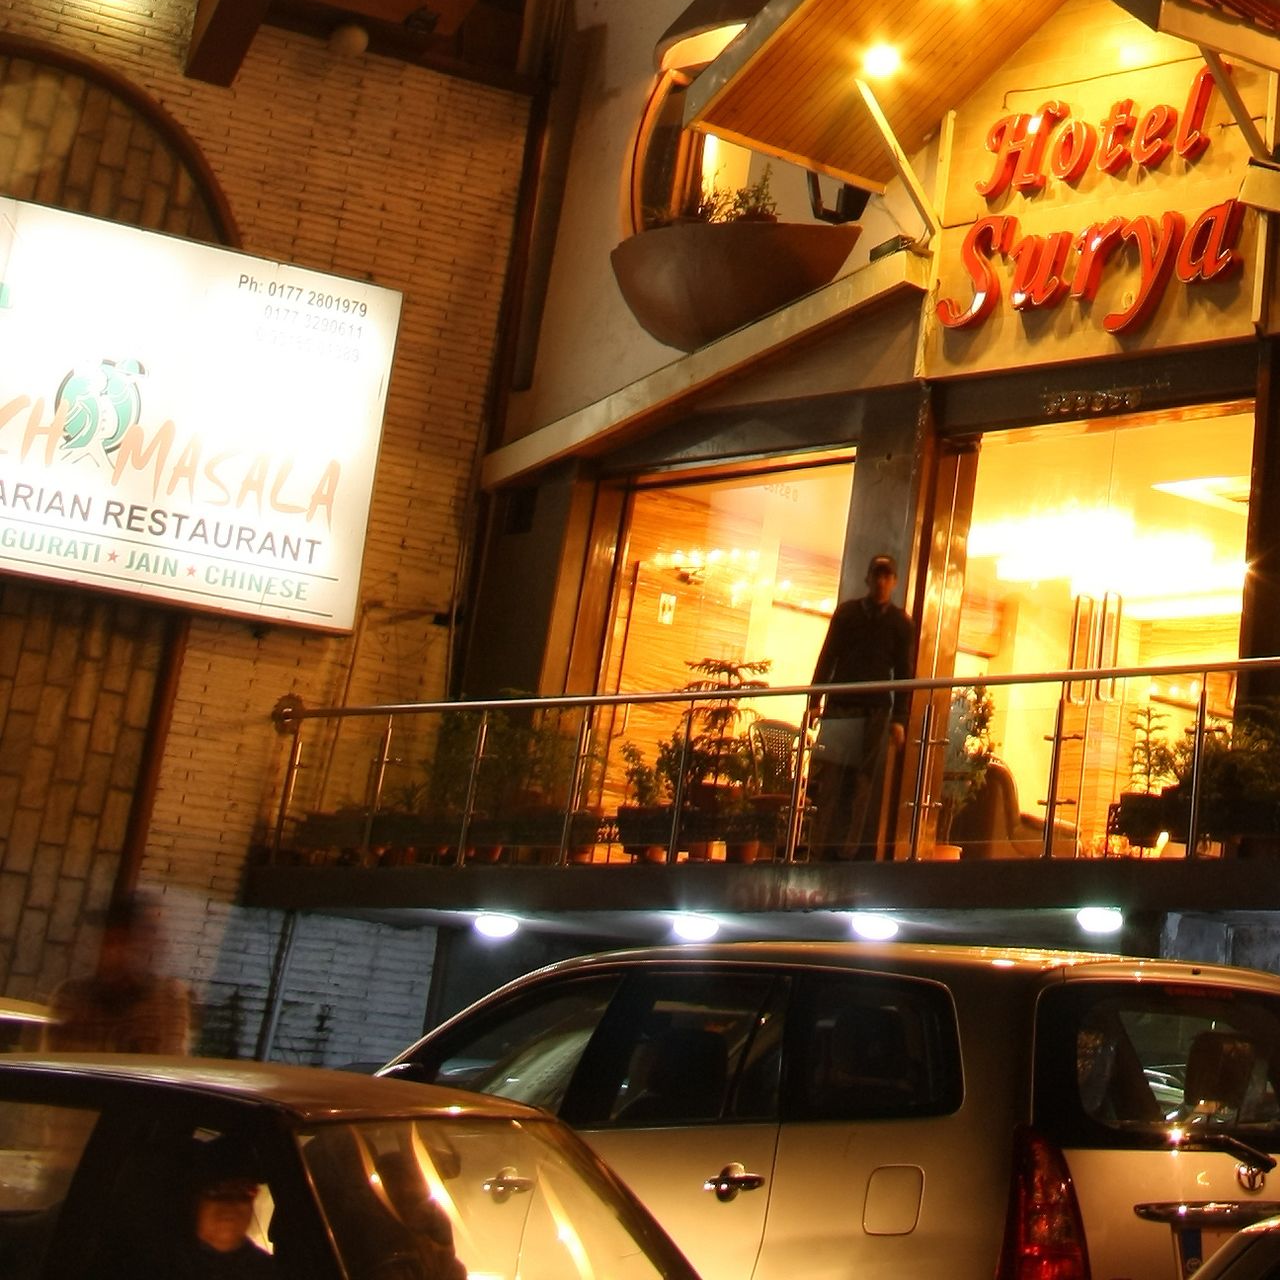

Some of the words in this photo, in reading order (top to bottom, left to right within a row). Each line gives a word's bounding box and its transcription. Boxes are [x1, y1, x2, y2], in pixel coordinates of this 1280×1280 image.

[974, 60, 1232, 199] Hotel
[238, 273, 264, 294] Ph:
[268, 280, 303, 303] 0177
[307, 290, 368, 318] 2801979
[935, 196, 1247, 335] Surya
[111, 419, 342, 532] MASALA
[1, 526, 101, 563] GUJRATI
[124, 550, 179, 578] JAIN
[204, 563, 309, 602] CHINESE
[103, 500, 323, 565] RESTAURANT
